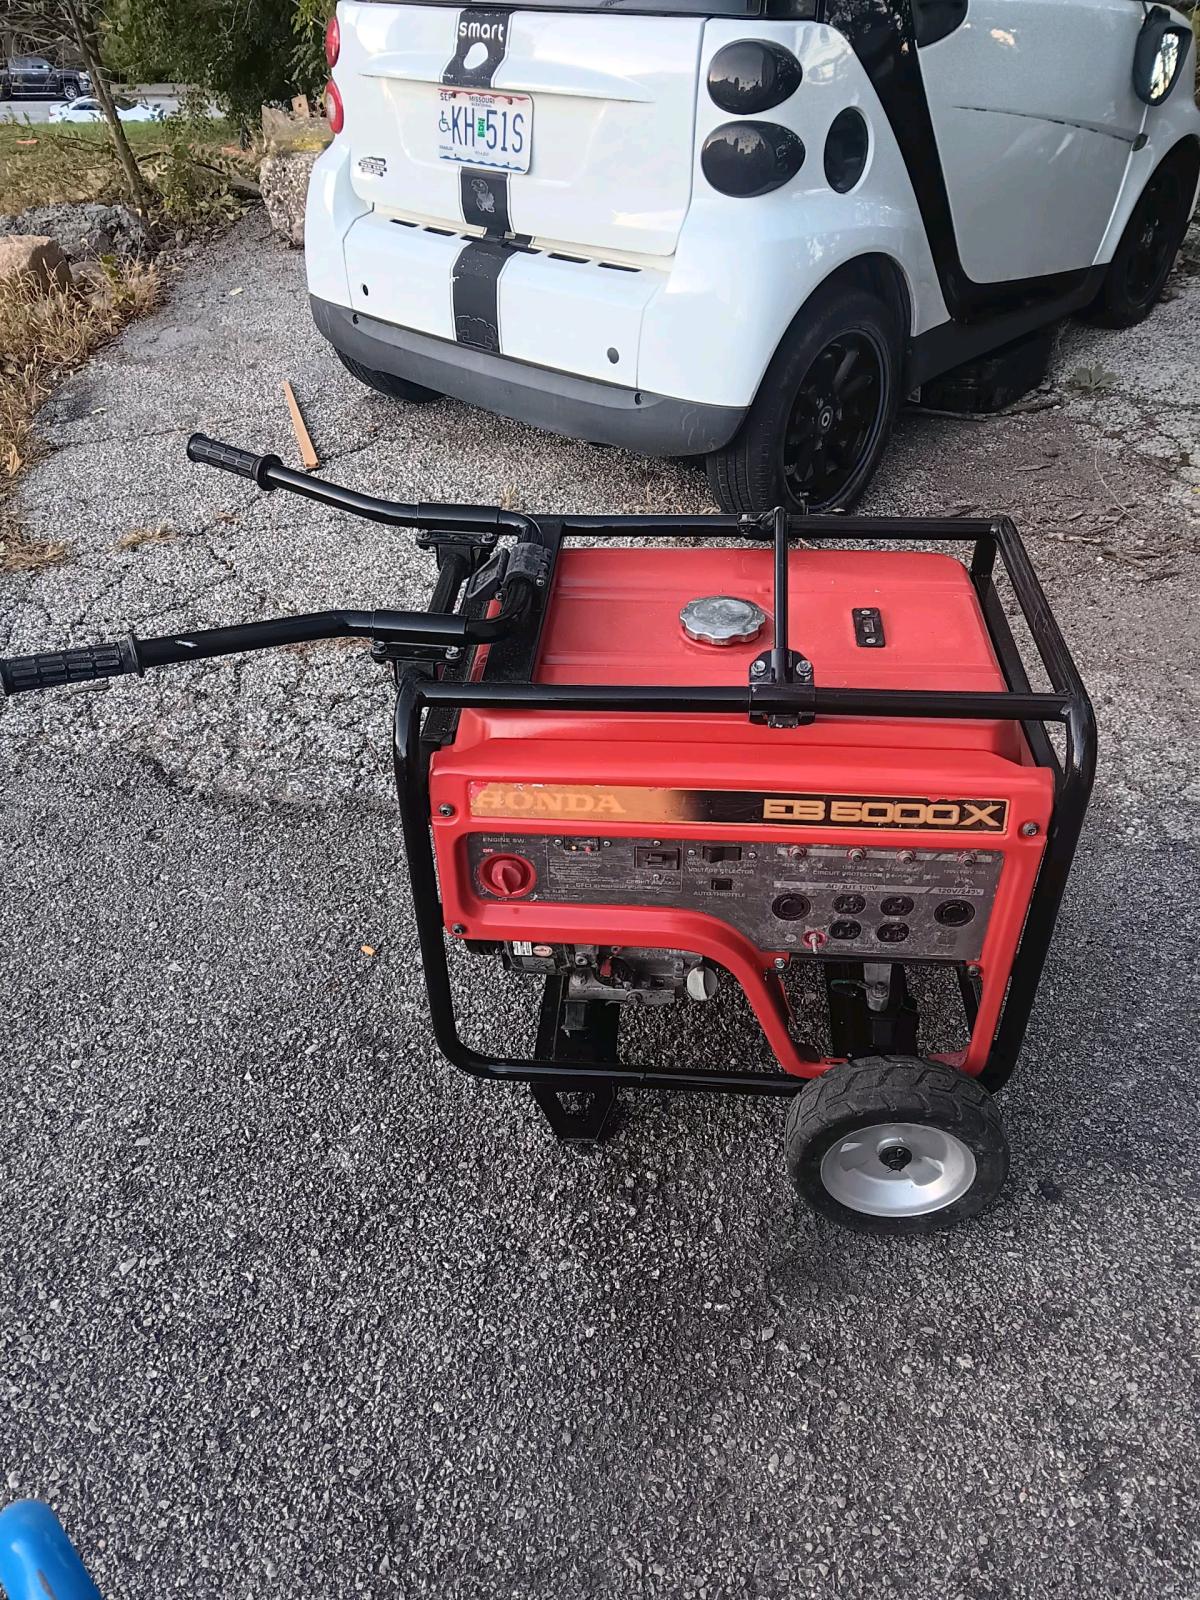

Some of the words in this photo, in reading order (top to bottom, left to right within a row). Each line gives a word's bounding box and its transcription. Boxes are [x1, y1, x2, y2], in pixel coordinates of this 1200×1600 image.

[459, 21, 504, 42] smart
[469, 95, 496, 104] MISSOURI
[451, 105, 475, 147] KH
[486, 109, 524, 153] 51S
[473, 789, 627, 814] HONDA
